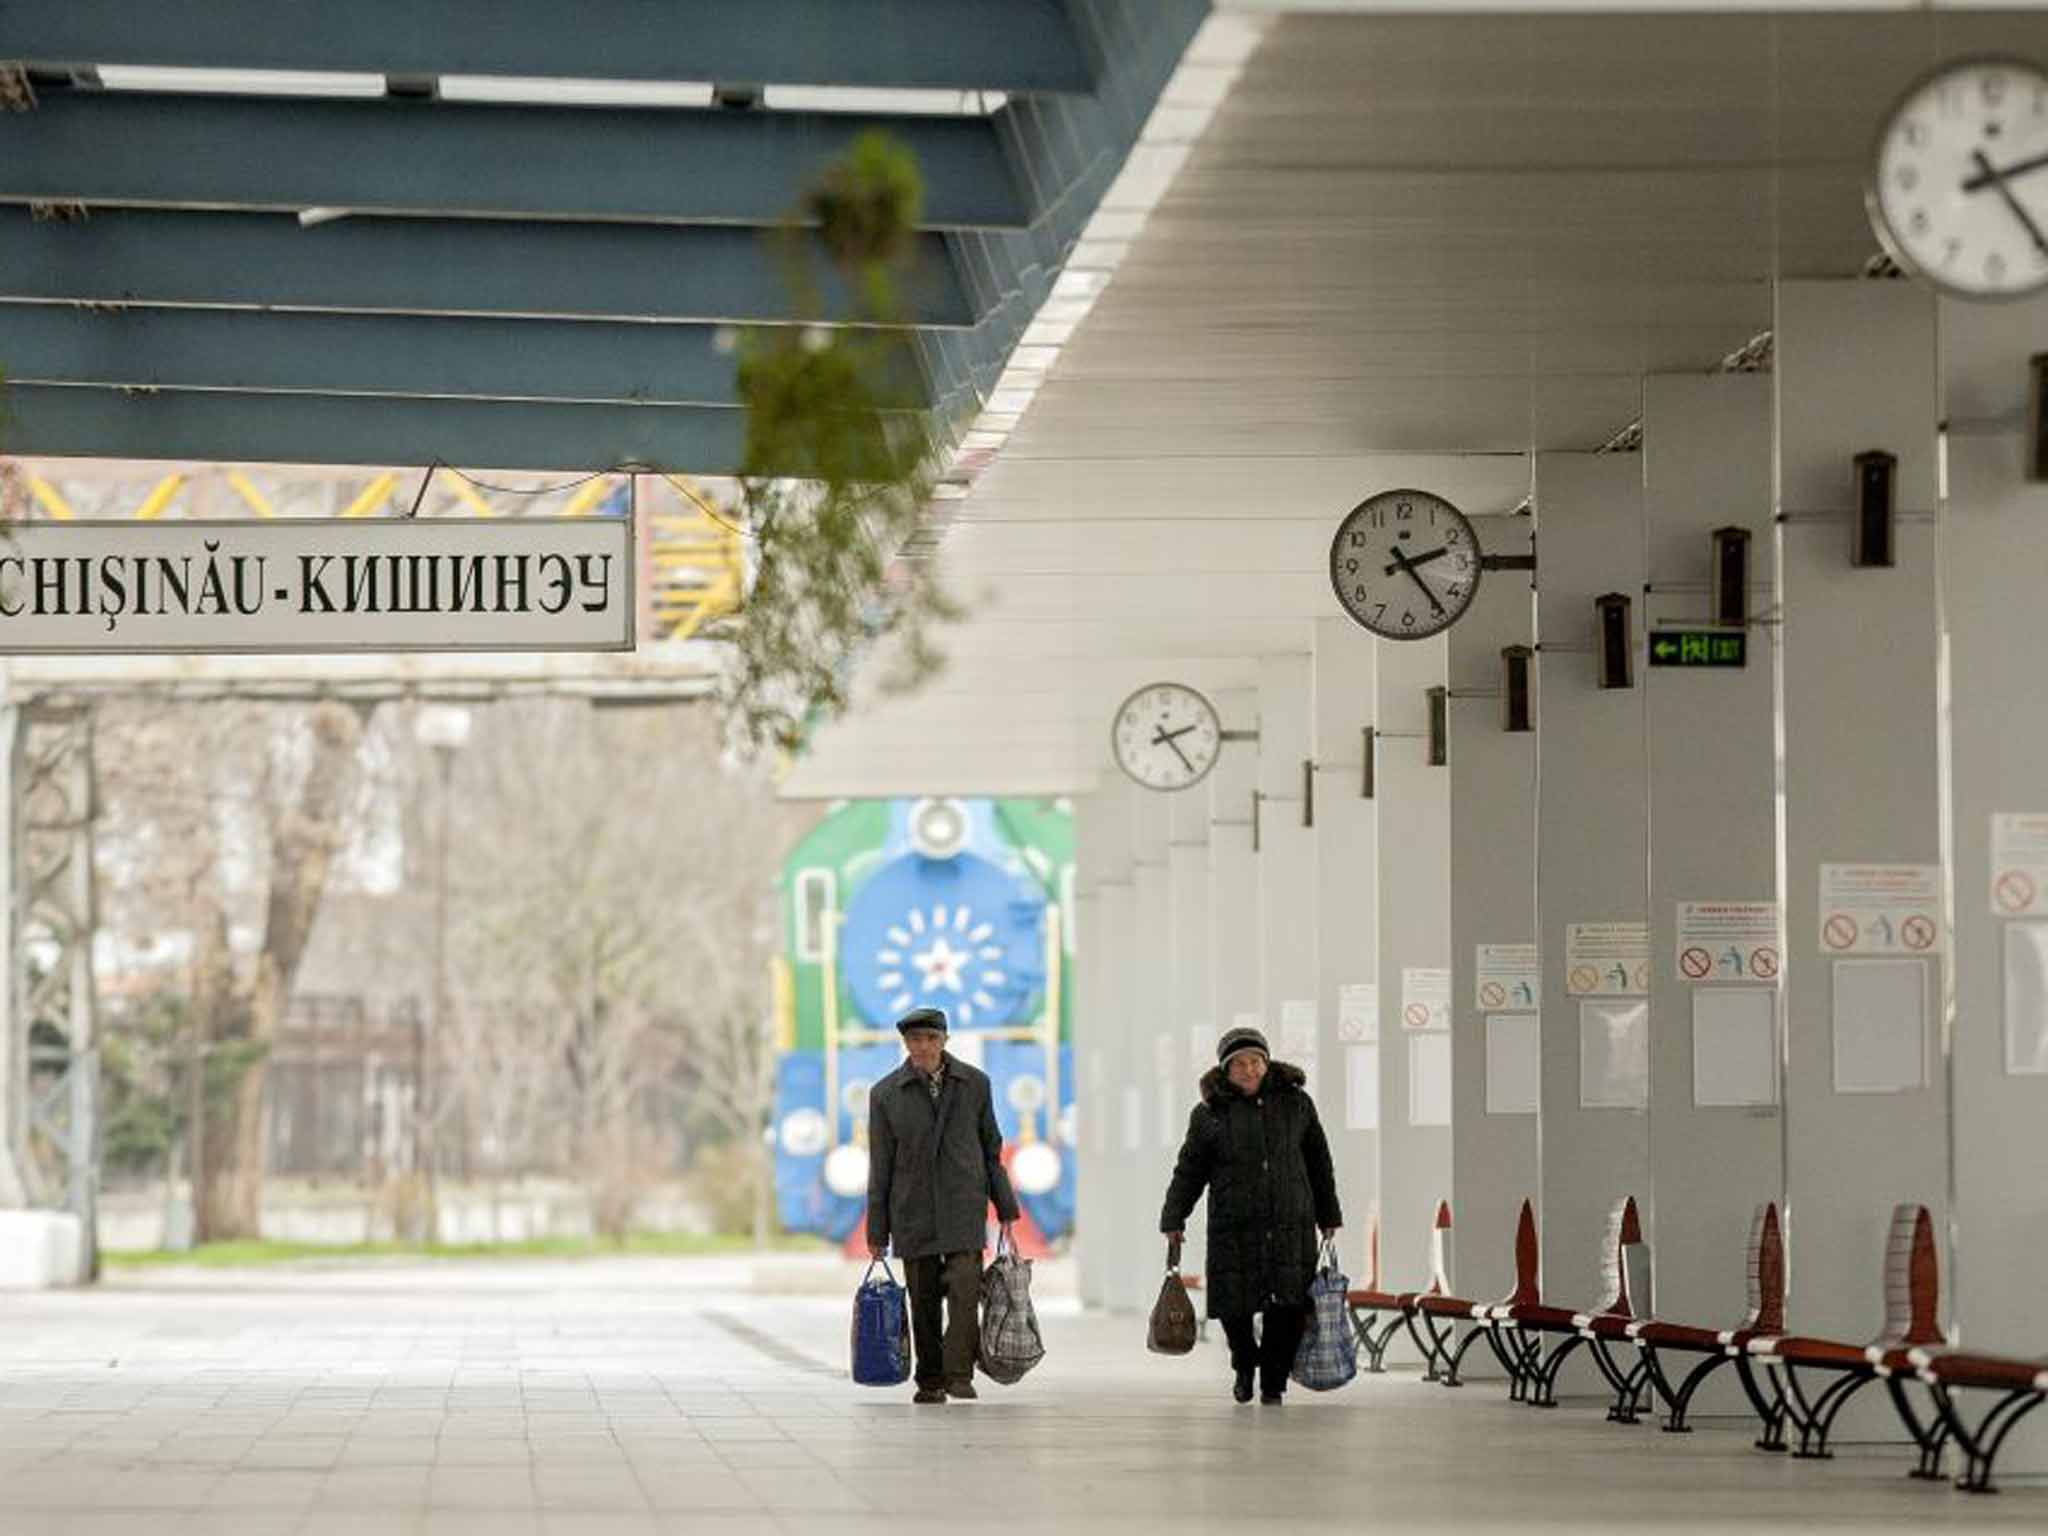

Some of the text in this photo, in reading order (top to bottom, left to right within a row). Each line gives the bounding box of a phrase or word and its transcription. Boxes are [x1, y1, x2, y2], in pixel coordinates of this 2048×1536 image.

[1372, 509, 1384, 528] 11
[1397, 503, 1412, 520] 12
[1347, 531, 1366, 547] 10
[1446, 529, 1458, 545] 2
[1346, 558, 1358, 574] 9
[1456, 554, 1468, 571] 3
[1355, 585, 1367, 602] 8
[1446, 582, 1460, 598] 4
[1376, 604, 1387, 622] 7
[1402, 609, 1415, 626] 6
